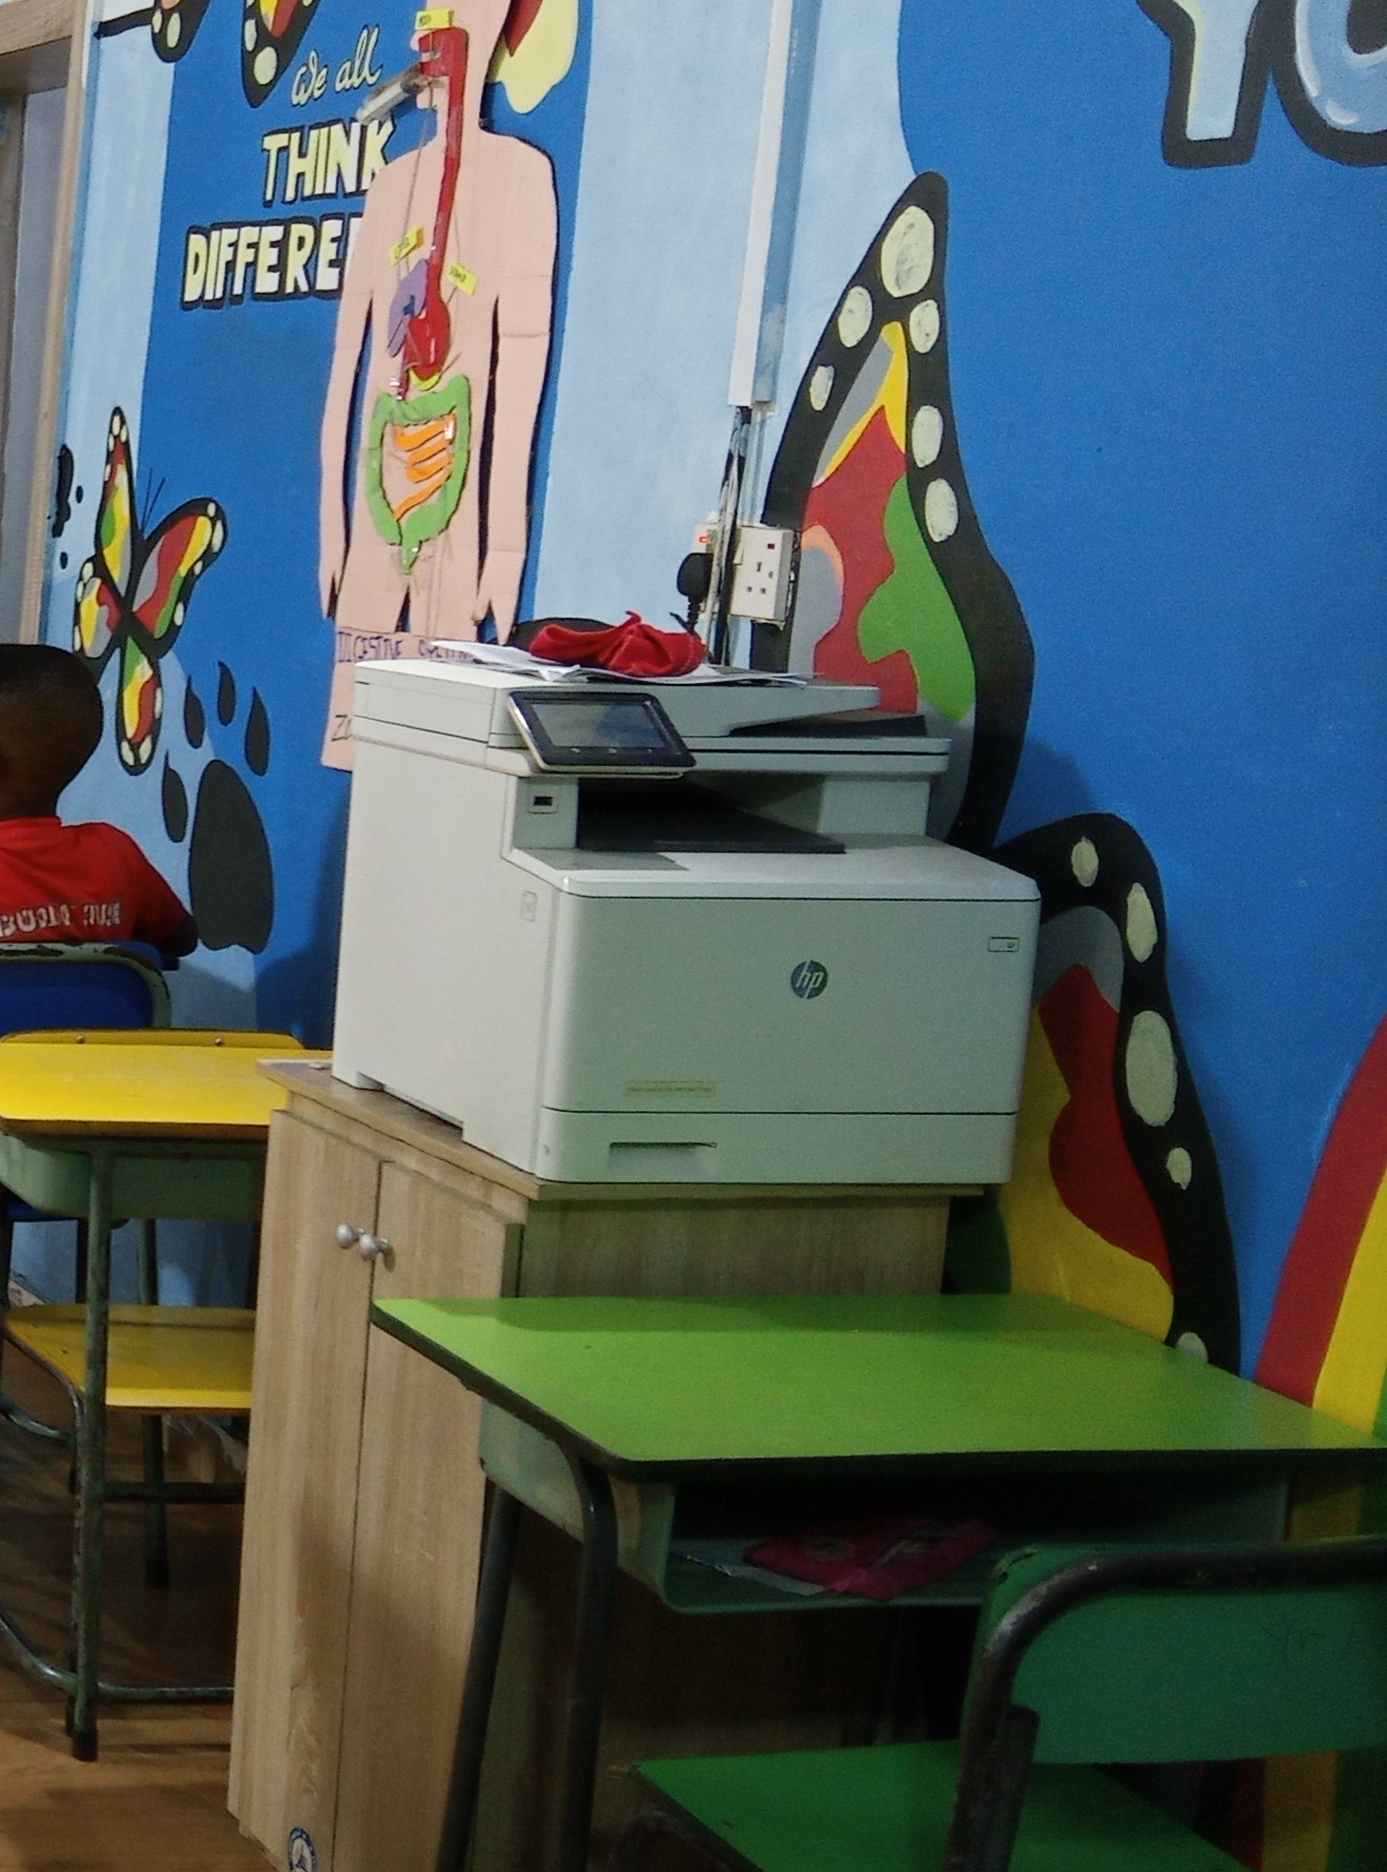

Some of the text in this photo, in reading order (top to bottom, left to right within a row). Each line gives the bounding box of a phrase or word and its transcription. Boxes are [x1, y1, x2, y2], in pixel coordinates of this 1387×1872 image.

[335, 23, 384, 93] all
[262, 113, 395, 206] THINK
[793, 960, 827, 999] hp
